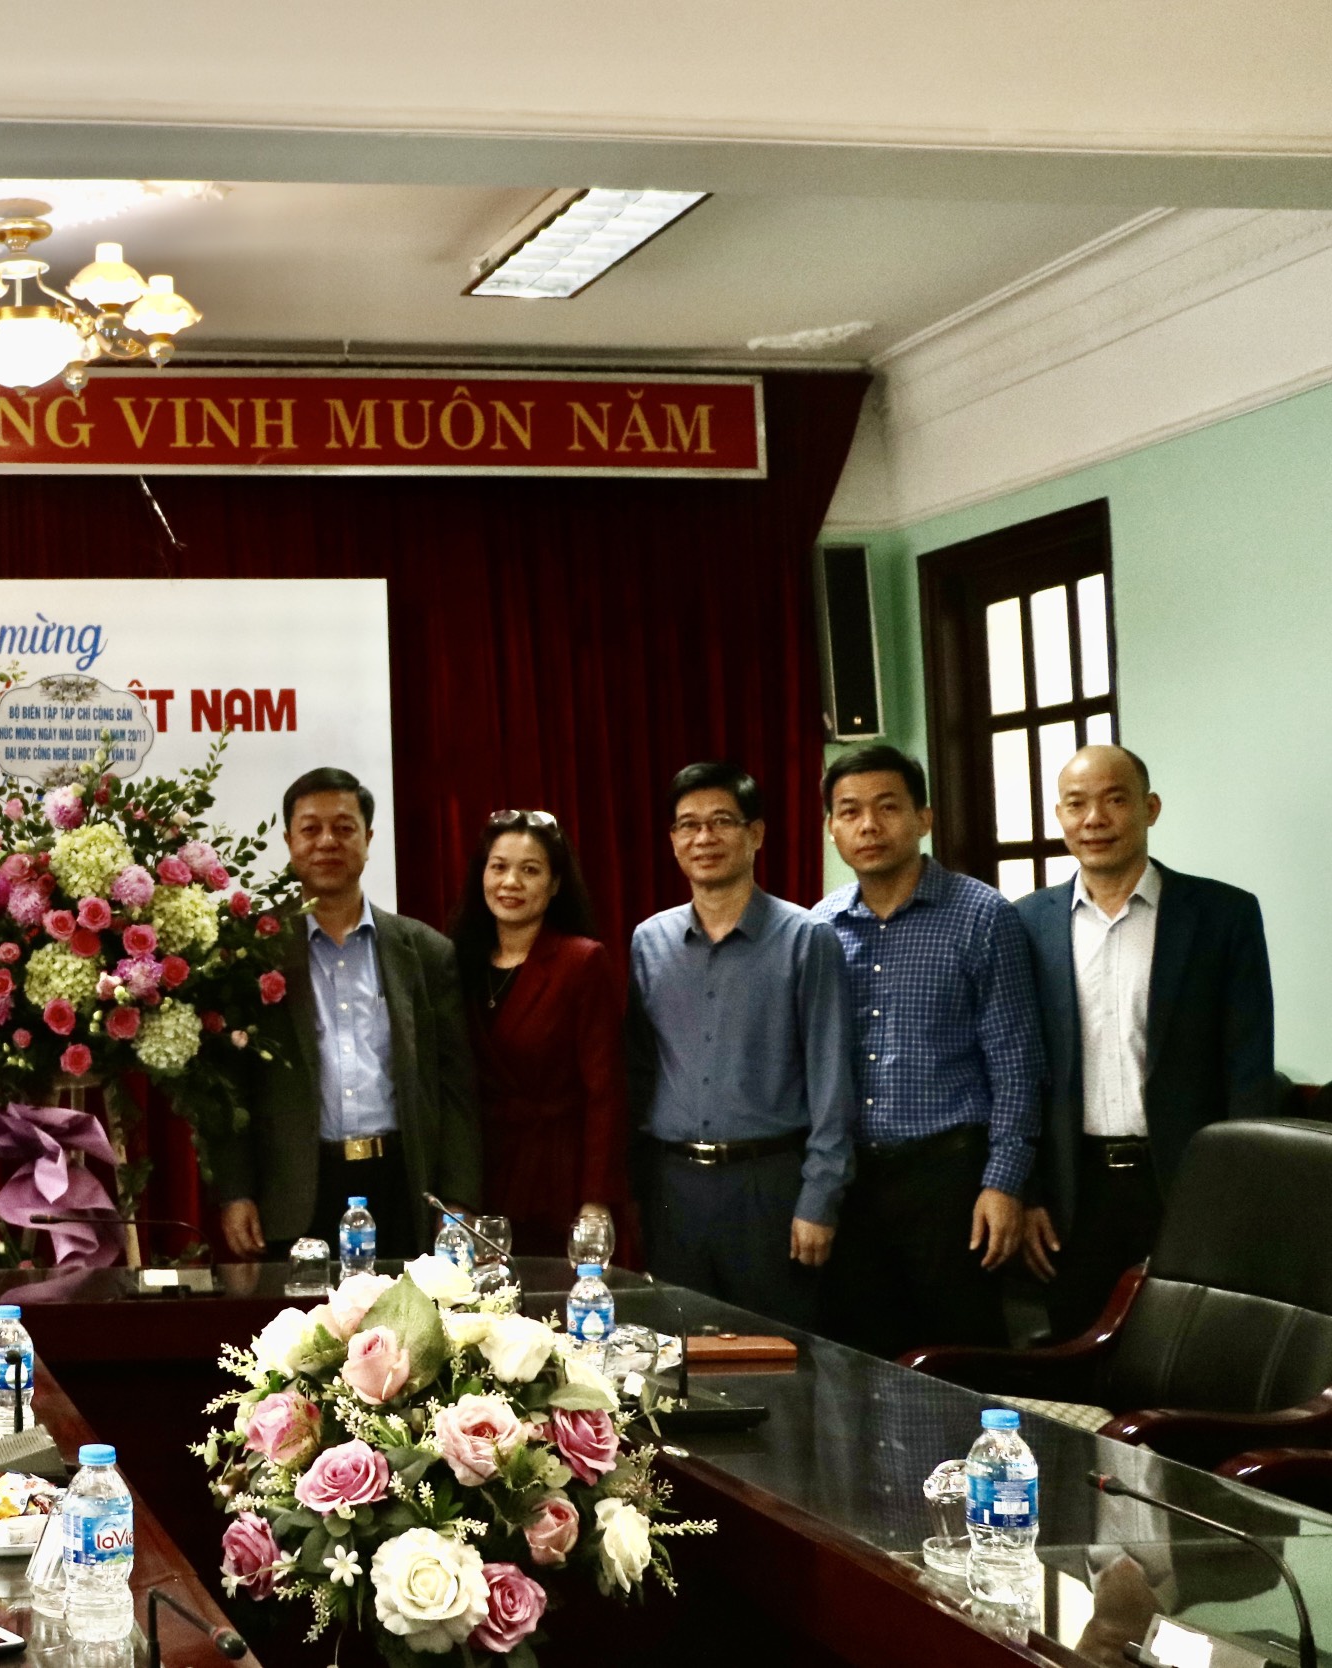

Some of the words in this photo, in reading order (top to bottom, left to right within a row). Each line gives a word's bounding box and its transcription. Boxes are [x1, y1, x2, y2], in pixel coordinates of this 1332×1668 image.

[113, 396, 297, 450] VINH
[324, 385, 536, 452] MUÔN
[566, 388, 716, 454] NĂM
[191, 688, 297, 733] NAM
